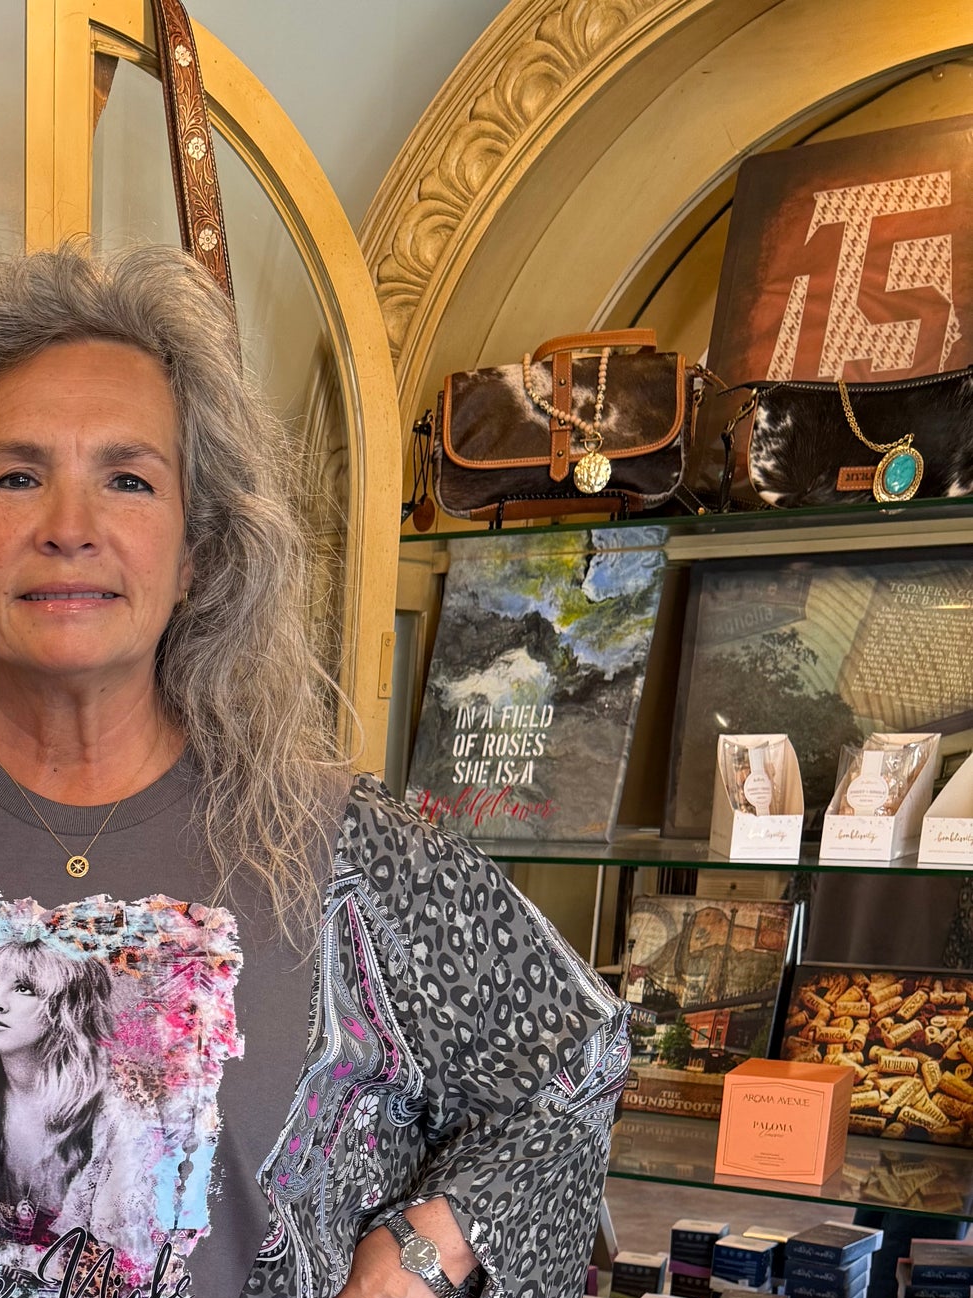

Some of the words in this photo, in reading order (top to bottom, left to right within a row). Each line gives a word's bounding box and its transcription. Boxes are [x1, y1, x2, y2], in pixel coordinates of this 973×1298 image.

[455, 705, 476, 730] IN
[480, 705, 493, 729] A
[500, 704, 554, 729] FIELD
[452, 733, 479, 757] OF
[482, 732, 546, 757] ROSES
[452, 760, 491, 784] SHE
[495, 760, 515, 784] IS
[519, 760, 534, 784] A
[660, 1090, 681, 1099] THE
[743, 1093, 775, 1104] AROMA
[777, 1096, 810, 1107] AVENUE
[752, 1120, 793, 1132] PALOMA
